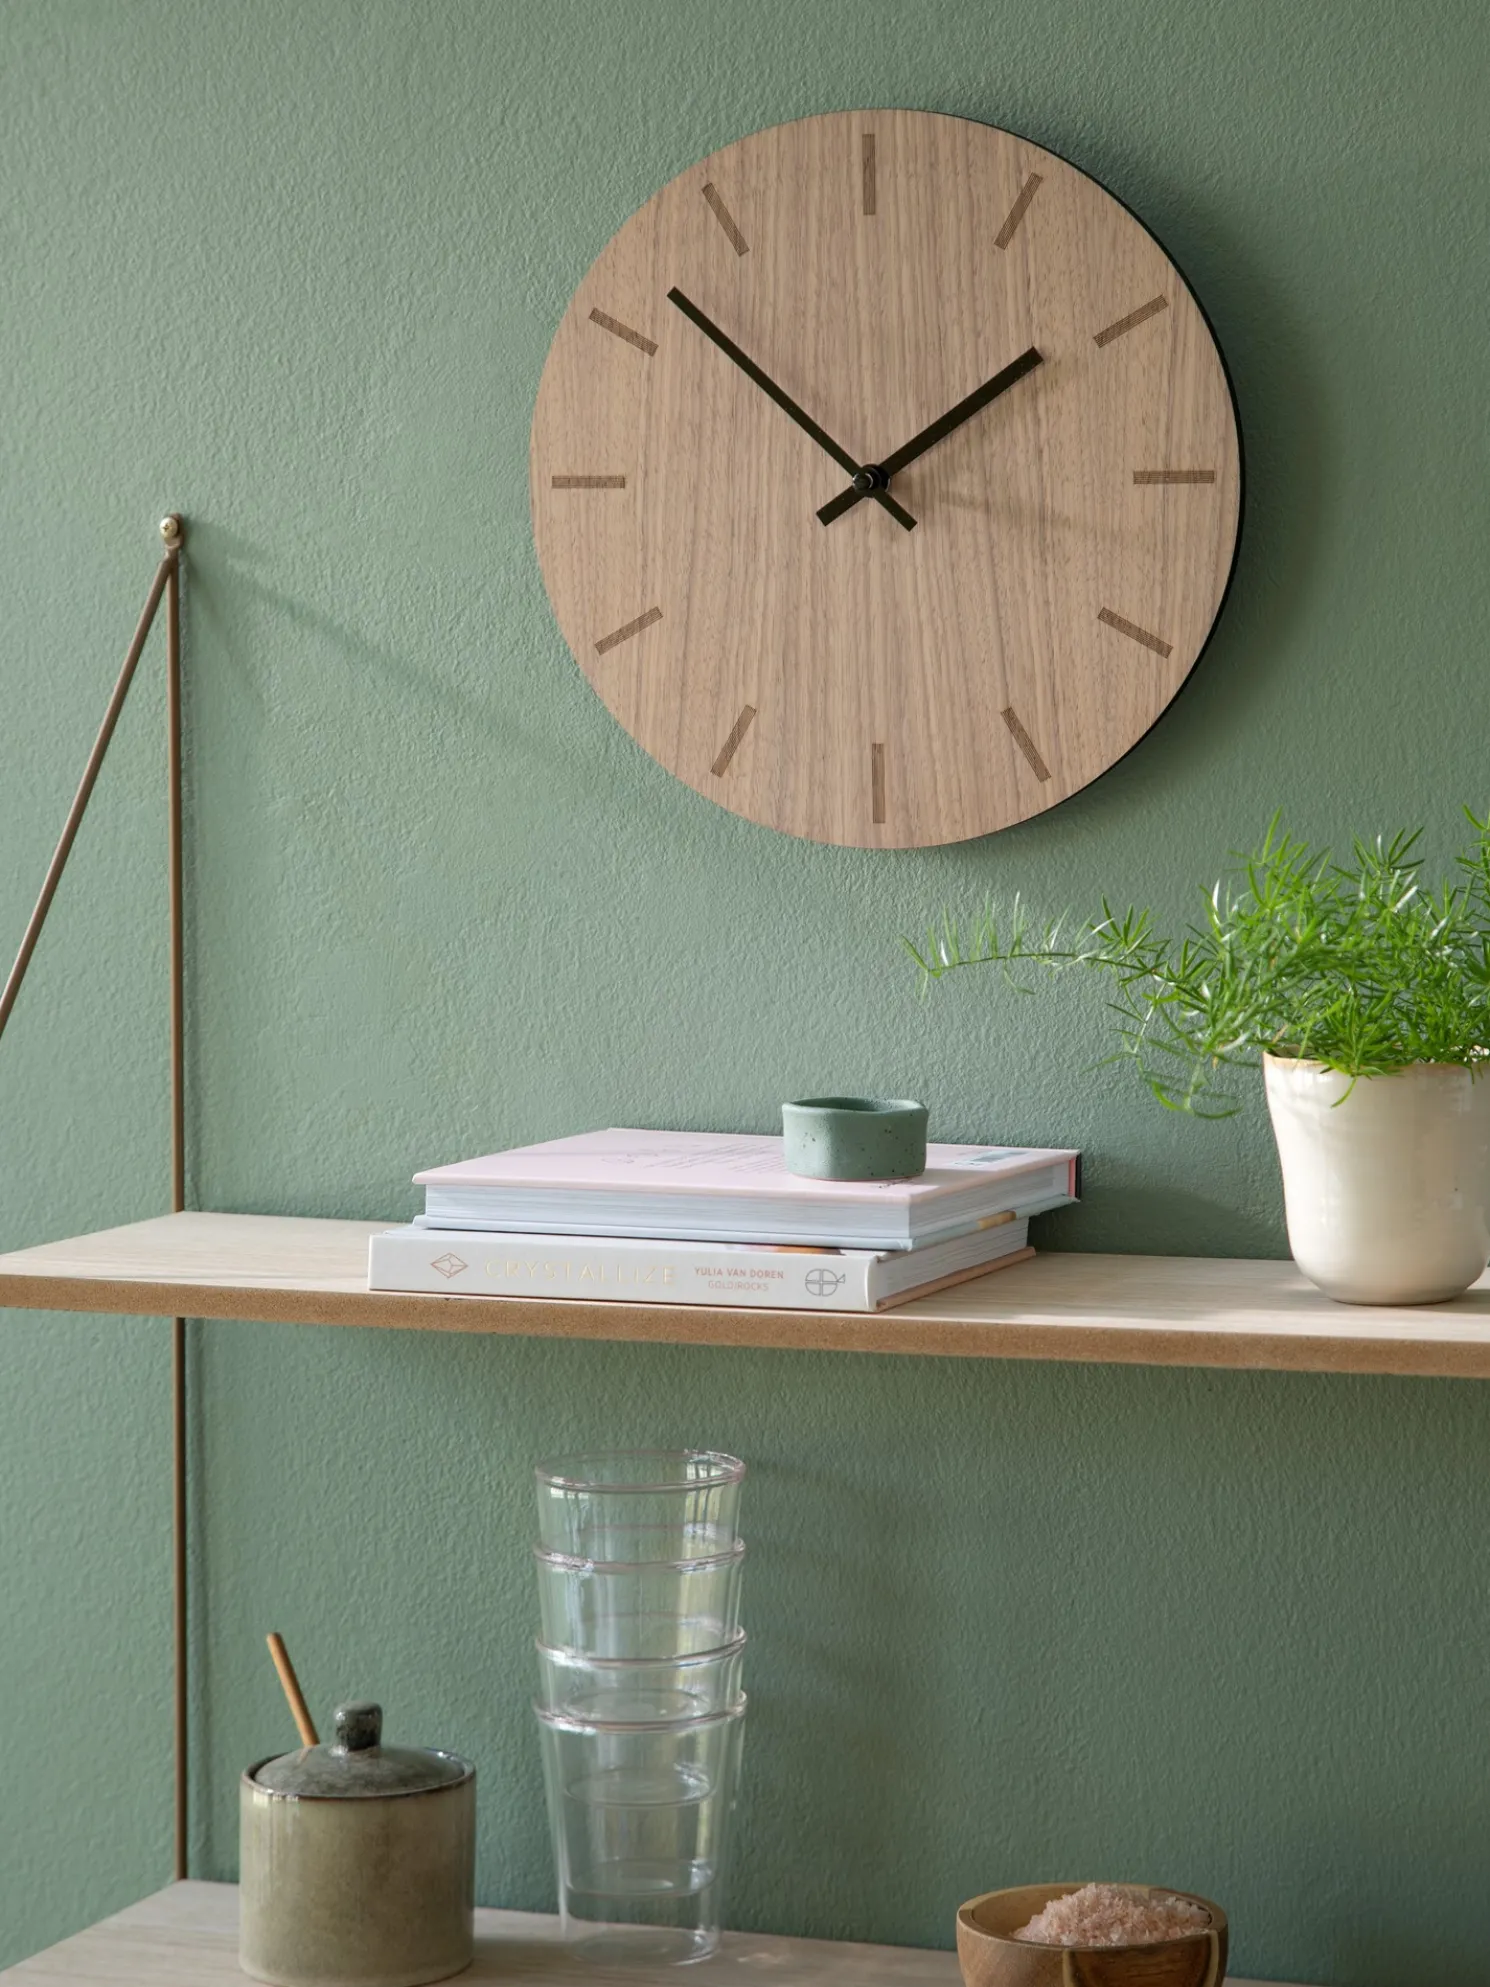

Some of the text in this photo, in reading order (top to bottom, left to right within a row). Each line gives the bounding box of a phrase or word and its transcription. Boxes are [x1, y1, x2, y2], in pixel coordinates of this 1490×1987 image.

[484, 1260, 676, 1285] CRYSTALLIZE
[693, 1267, 785, 1280] YULIA VAN DOREN
